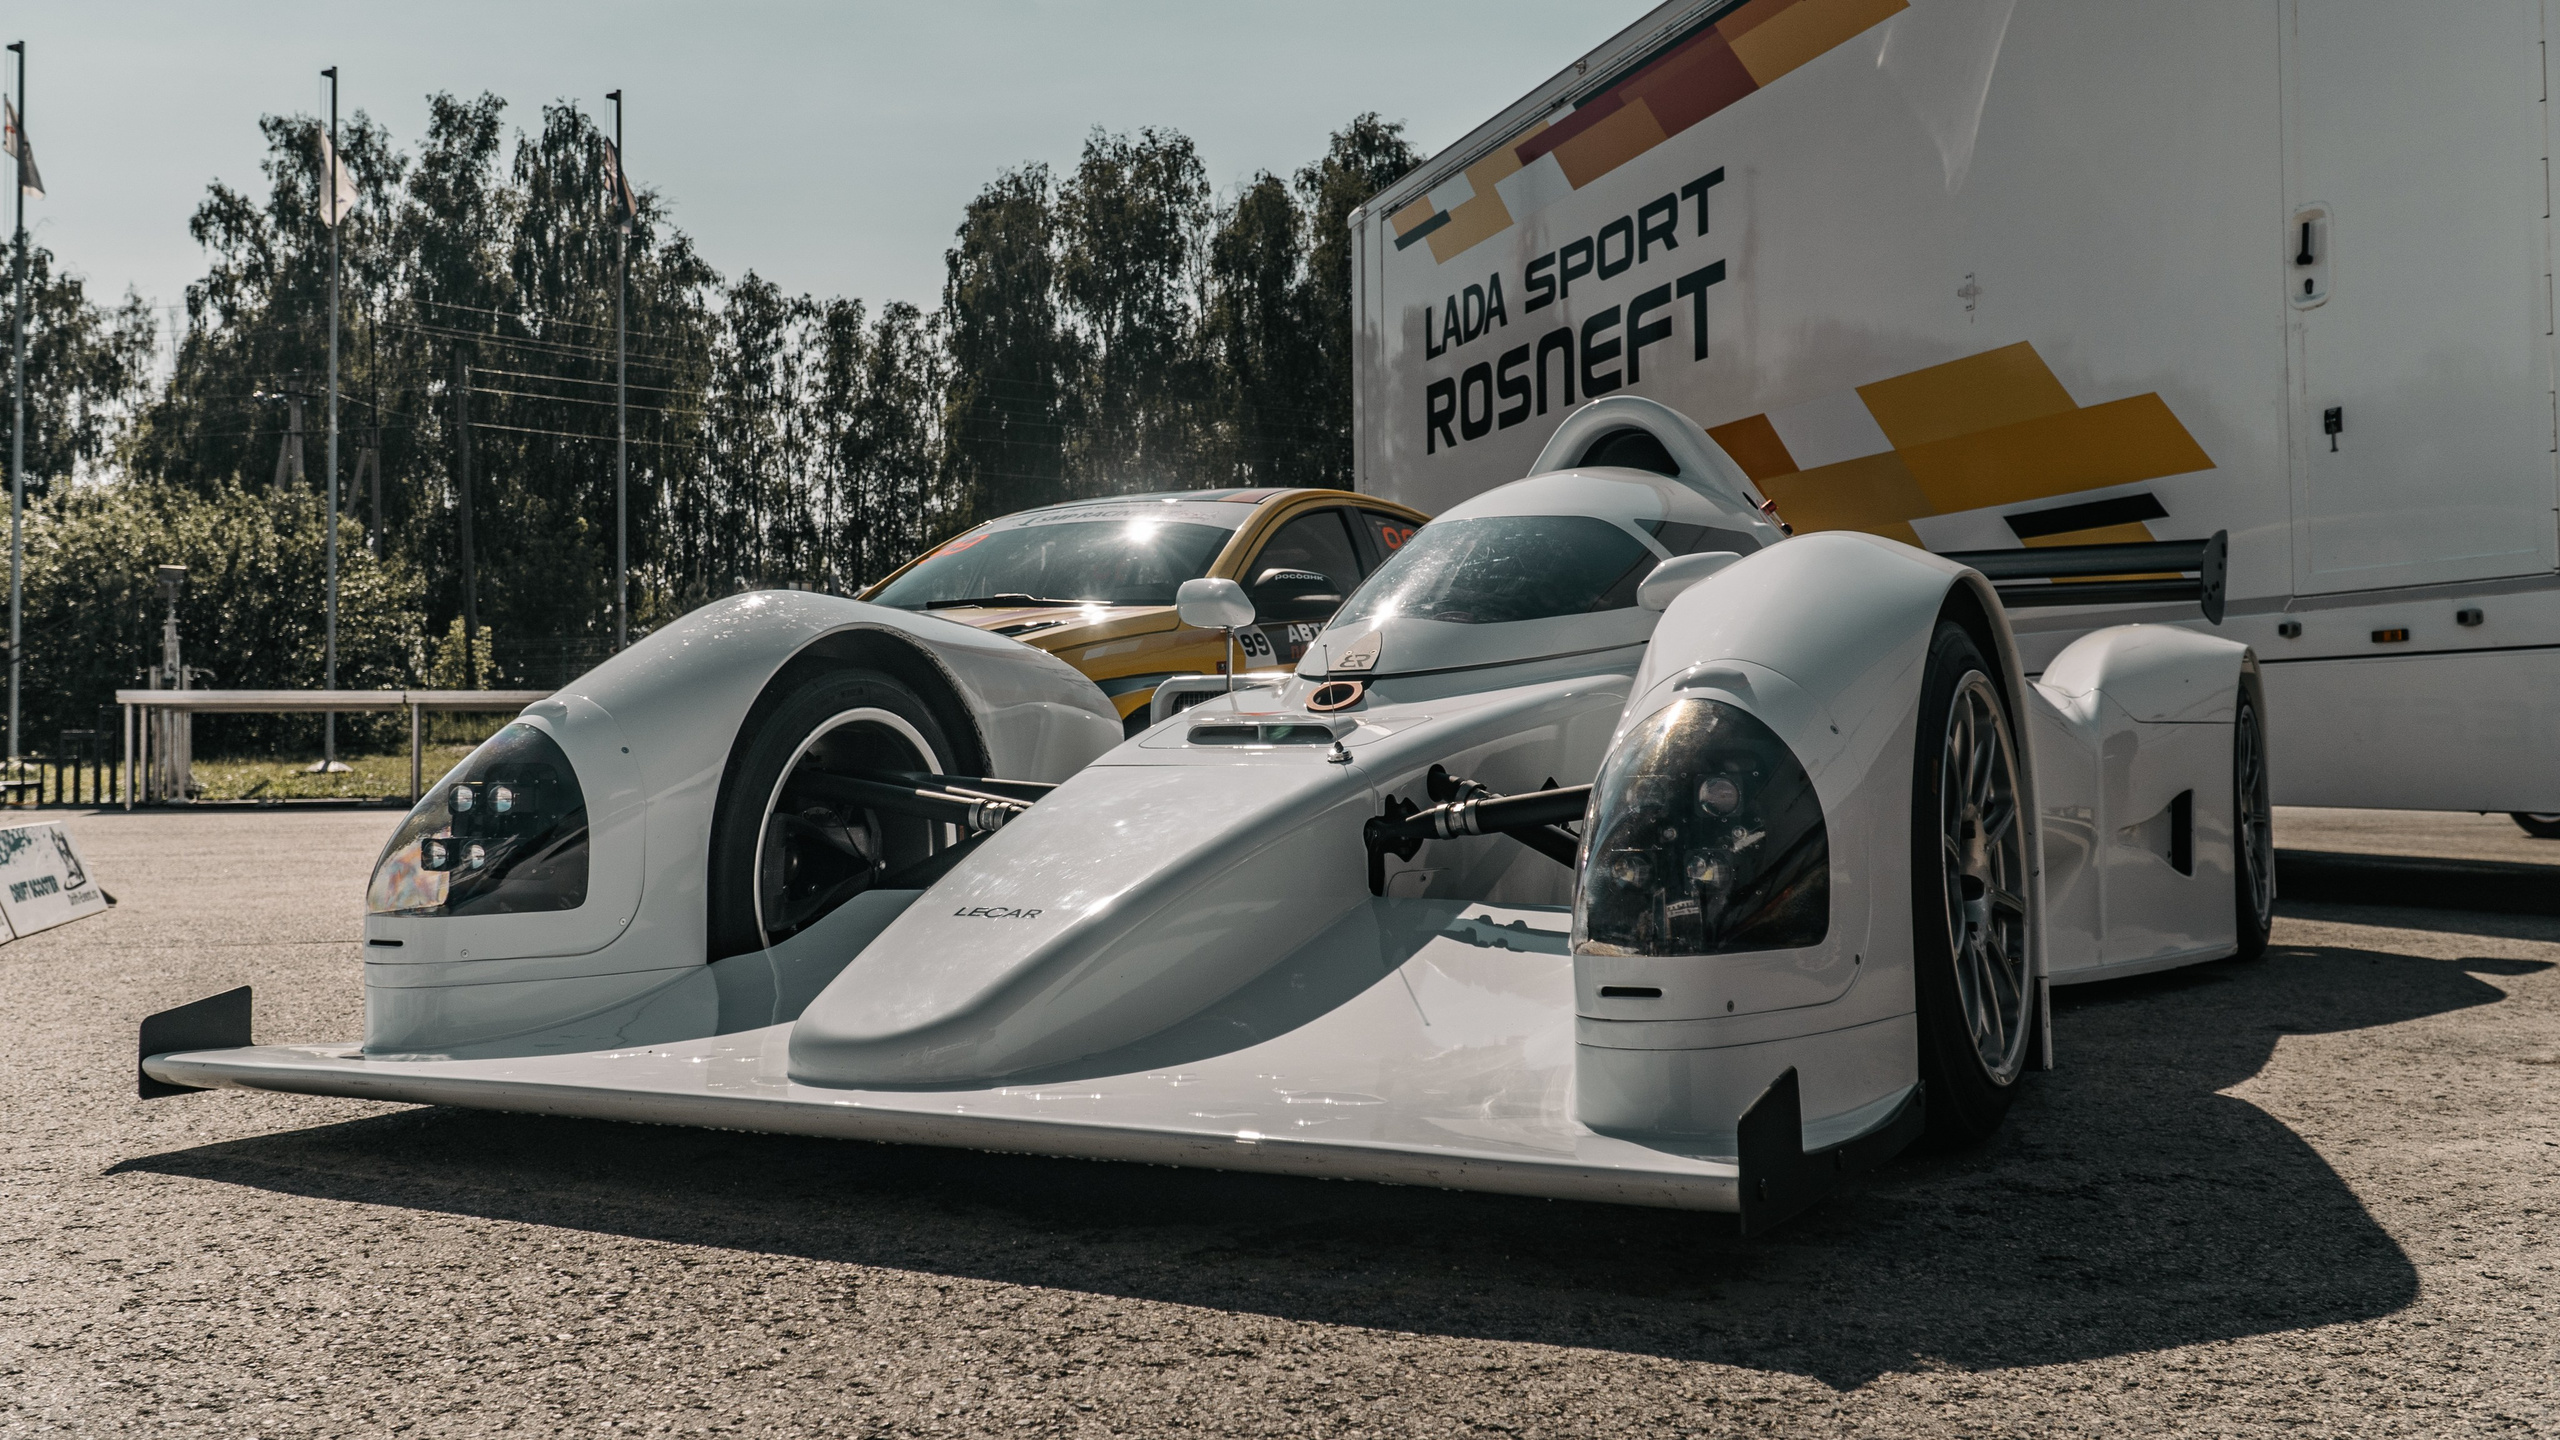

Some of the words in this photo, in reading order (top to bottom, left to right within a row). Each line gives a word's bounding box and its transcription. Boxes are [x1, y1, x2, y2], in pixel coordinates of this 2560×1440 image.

[1425, 272, 1508, 362] LADA
[1524, 165, 1726, 315] SPORT
[1426, 258, 1727, 456] ROSNEFT
[1275, 573, 1324, 581] росбанк
[1287, 623, 1326, 643] АВТ
[1240, 632, 1271, 658] 99
[953, 906, 1044, 919] LECAR
